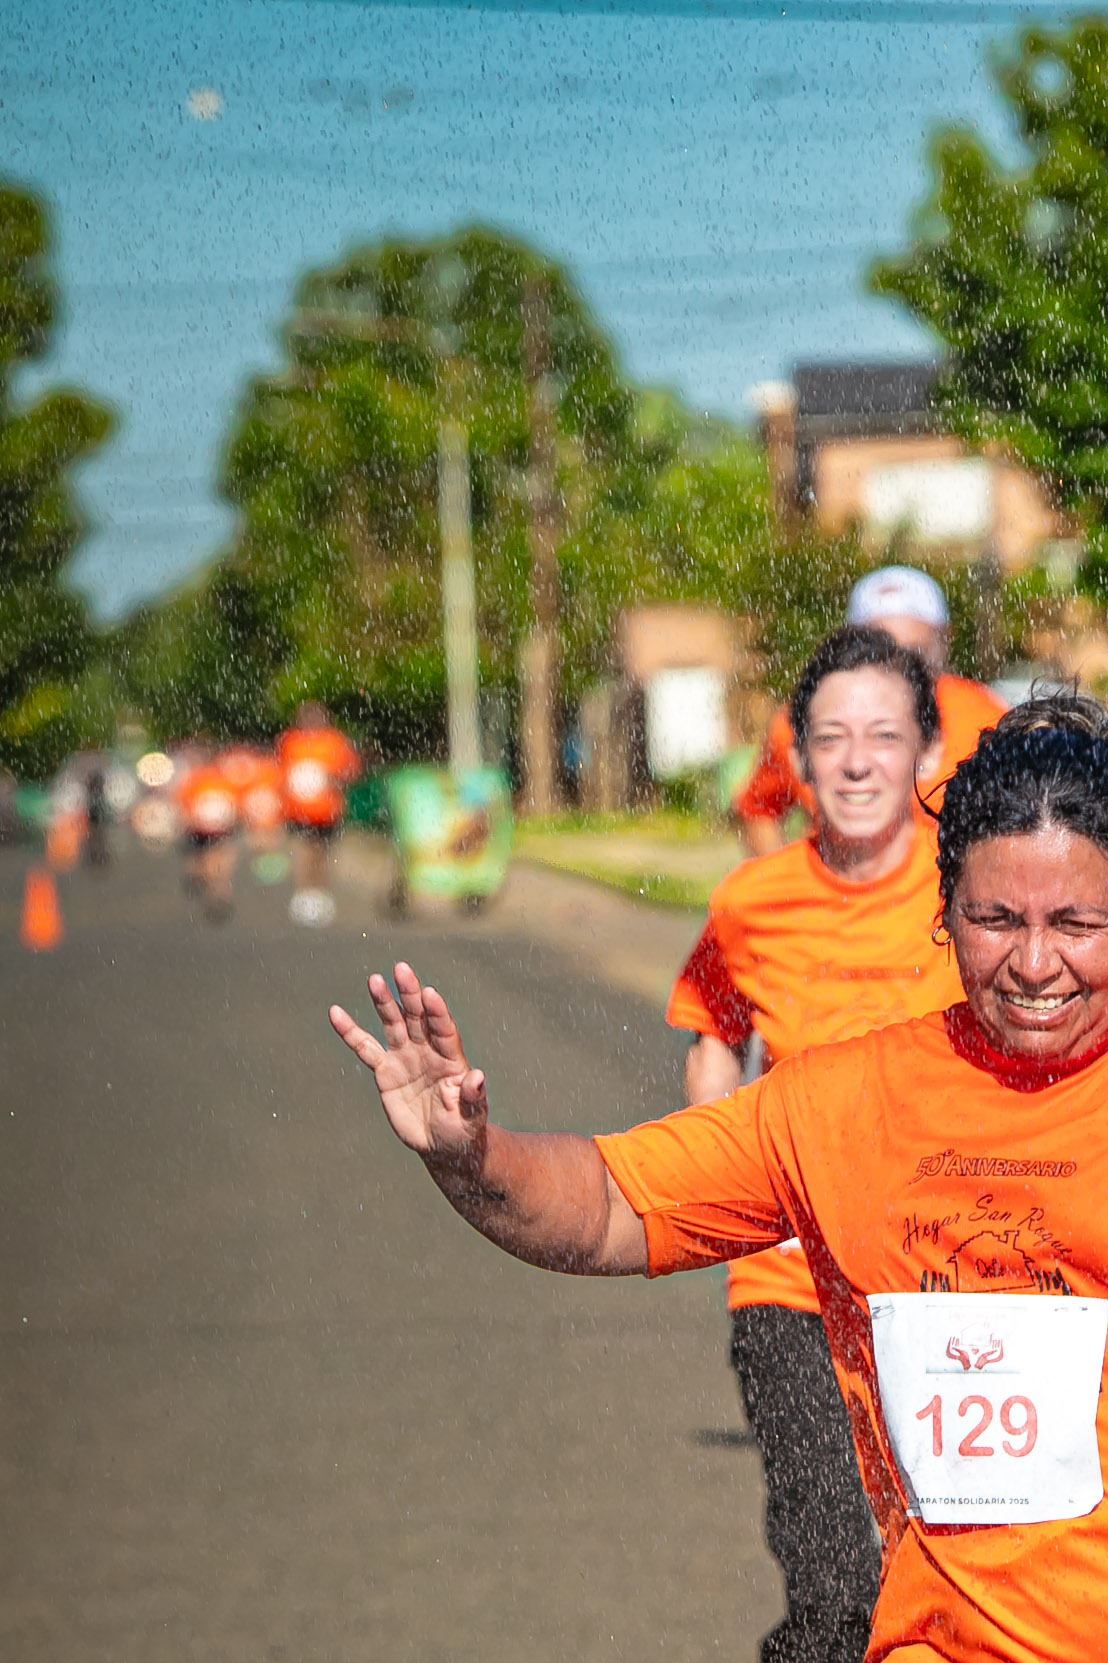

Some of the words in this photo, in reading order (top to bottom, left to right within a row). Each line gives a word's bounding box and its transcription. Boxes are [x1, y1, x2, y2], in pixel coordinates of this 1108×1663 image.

[945, 1155, 1077, 1178] ANIVERSARIO
[903, 1213, 961, 1254] Hogar
[968, 1194, 1012, 1222] San
[1017, 1207, 1073, 1254] Roque
[915, 1394, 1038, 1458] 129
